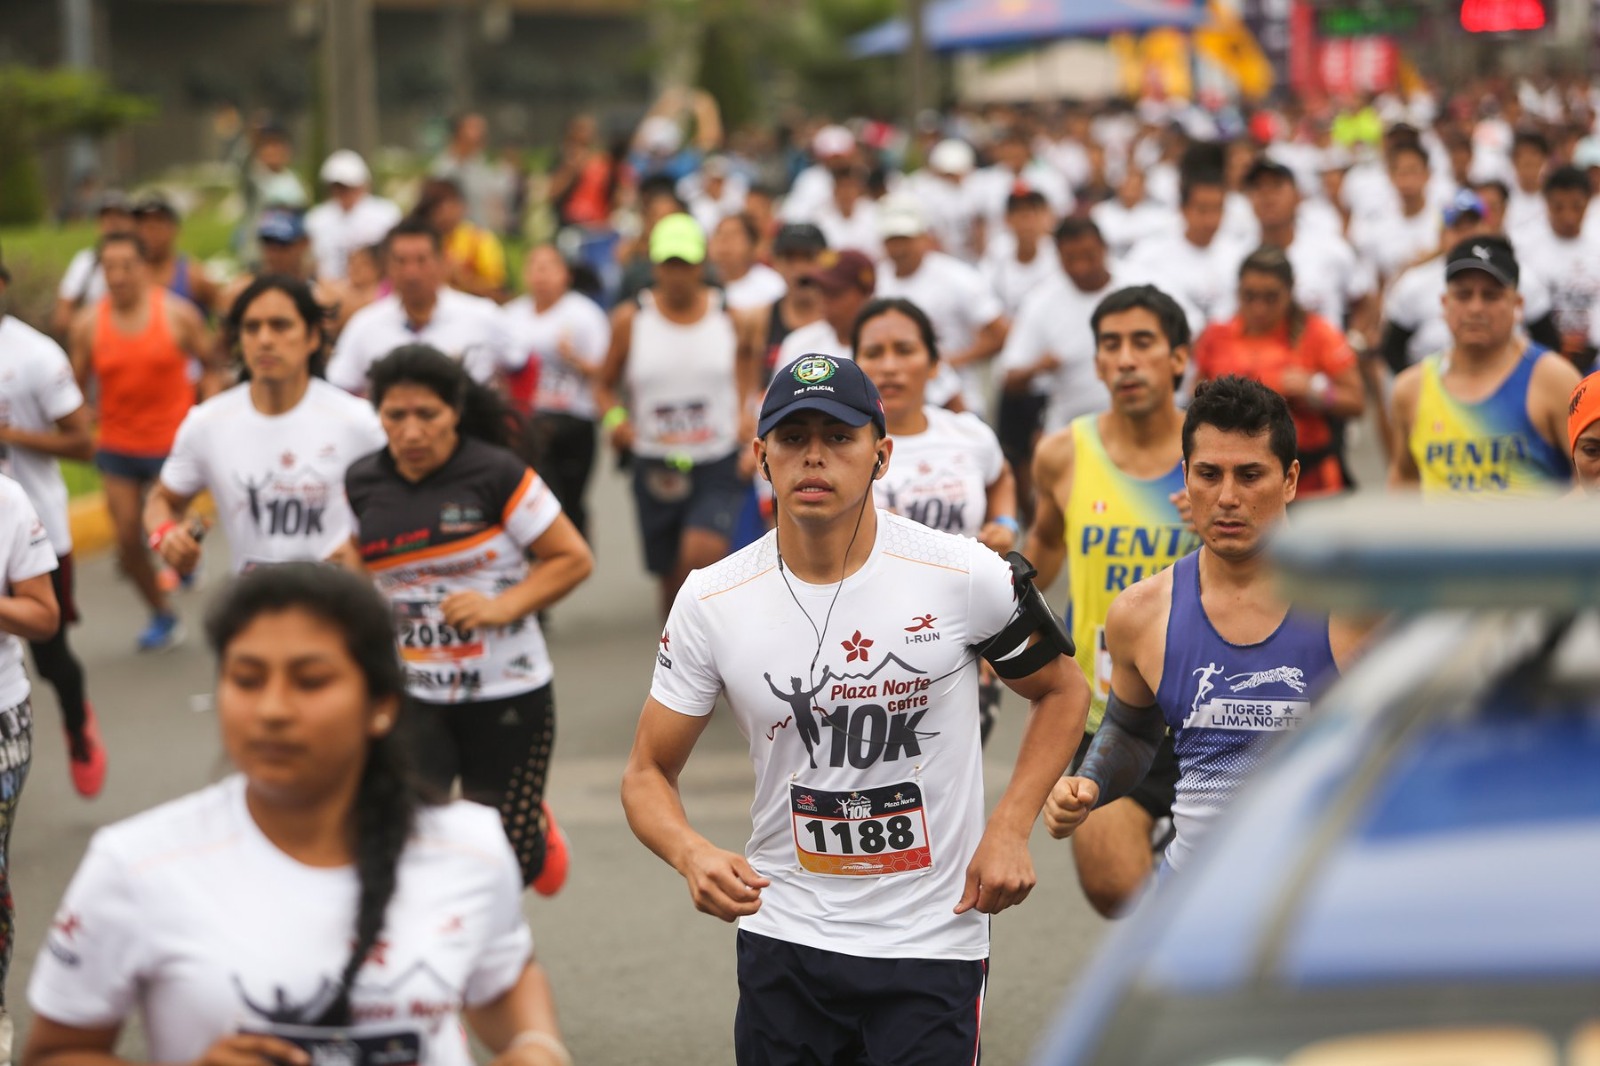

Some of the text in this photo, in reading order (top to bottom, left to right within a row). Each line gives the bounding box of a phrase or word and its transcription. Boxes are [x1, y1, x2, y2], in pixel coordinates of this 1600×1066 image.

[807, 385, 835, 393] POLICIAL
[1427, 437, 1526, 465] PENTA
[266, 498, 325, 536] 10K
[905, 498, 967, 531] 10K
[1105, 563, 1170, 592] RU
[905, 632, 941, 644] I-RUN
[830, 677, 931, 701] Plaza Norte
[887, 695, 928, 712] corre
[1222, 703, 1273, 716] TIGRES
[821, 703, 930, 770] 10K
[848, 806, 872, 820] 10K
[900, 797, 916, 806] Norte
[805, 815, 915, 854] 1188
